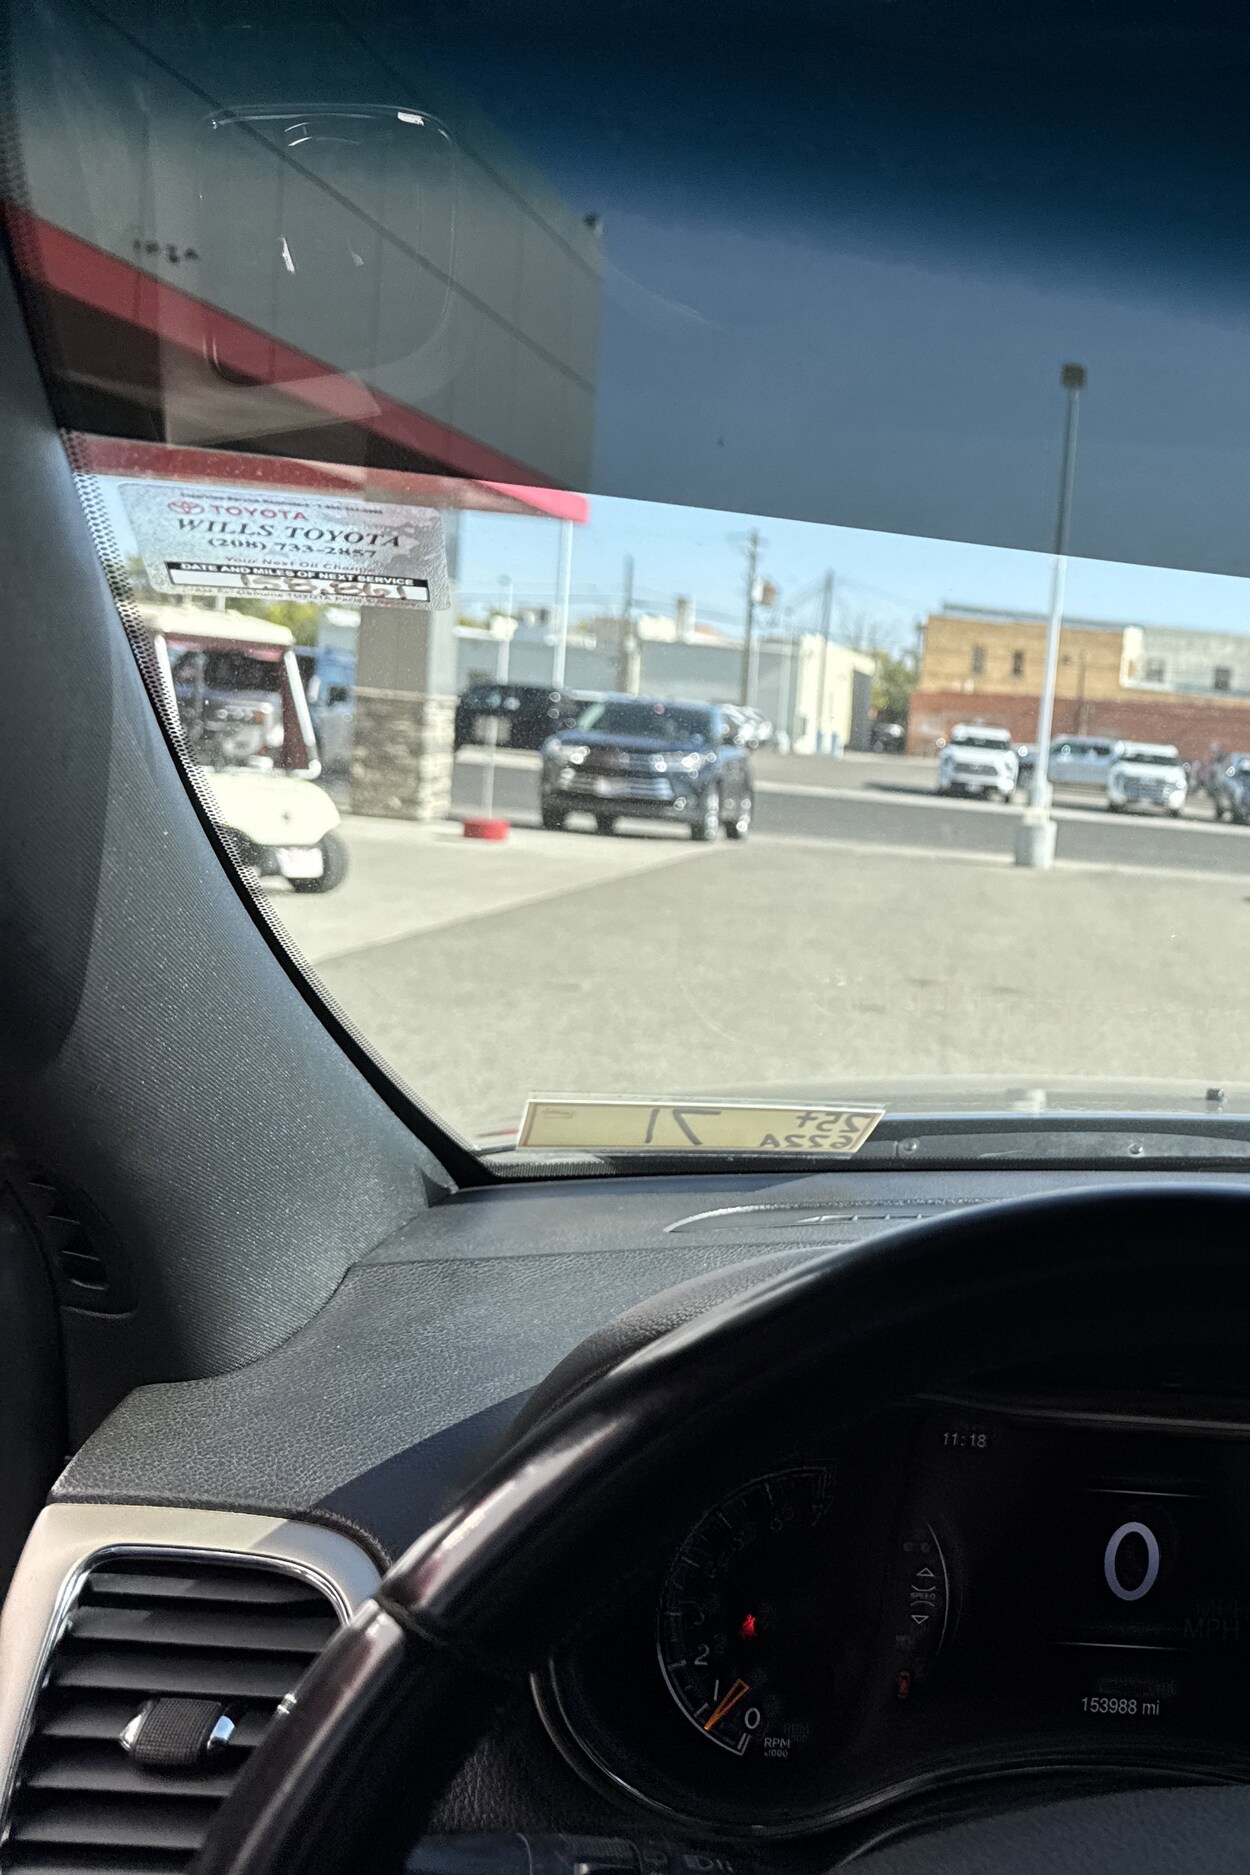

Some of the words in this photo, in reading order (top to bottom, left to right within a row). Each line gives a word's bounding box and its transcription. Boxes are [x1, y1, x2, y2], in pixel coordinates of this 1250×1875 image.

[209, 504, 309, 521] TOYOTA
[178, 518, 275, 537] WILLS
[285, 525, 400, 547] TOYOTA
[208, 538, 267, 552] (208)
[275, 542, 377, 558] 733-2857
[180, 562, 219, 573] DATE
[220, 565, 251, 575] AND
[253, 568, 295, 578] MILES
[297, 570, 317, 579] OF
[320, 572, 355, 582] NEXT
[357, 575, 415, 586] SERVICE
[943, 1432, 987, 1448] 11:18
[1104, 1521, 1160, 1601] 0
[910, 1592, 936, 1600] SPEED
[693, 1643, 711, 1667] 2
[1081, 1697, 1138, 1716] 153988
[1142, 1699, 1161, 1716] mi
[743, 1706, 761, 1730] 0
[763, 1737, 792, 1749] RPM
